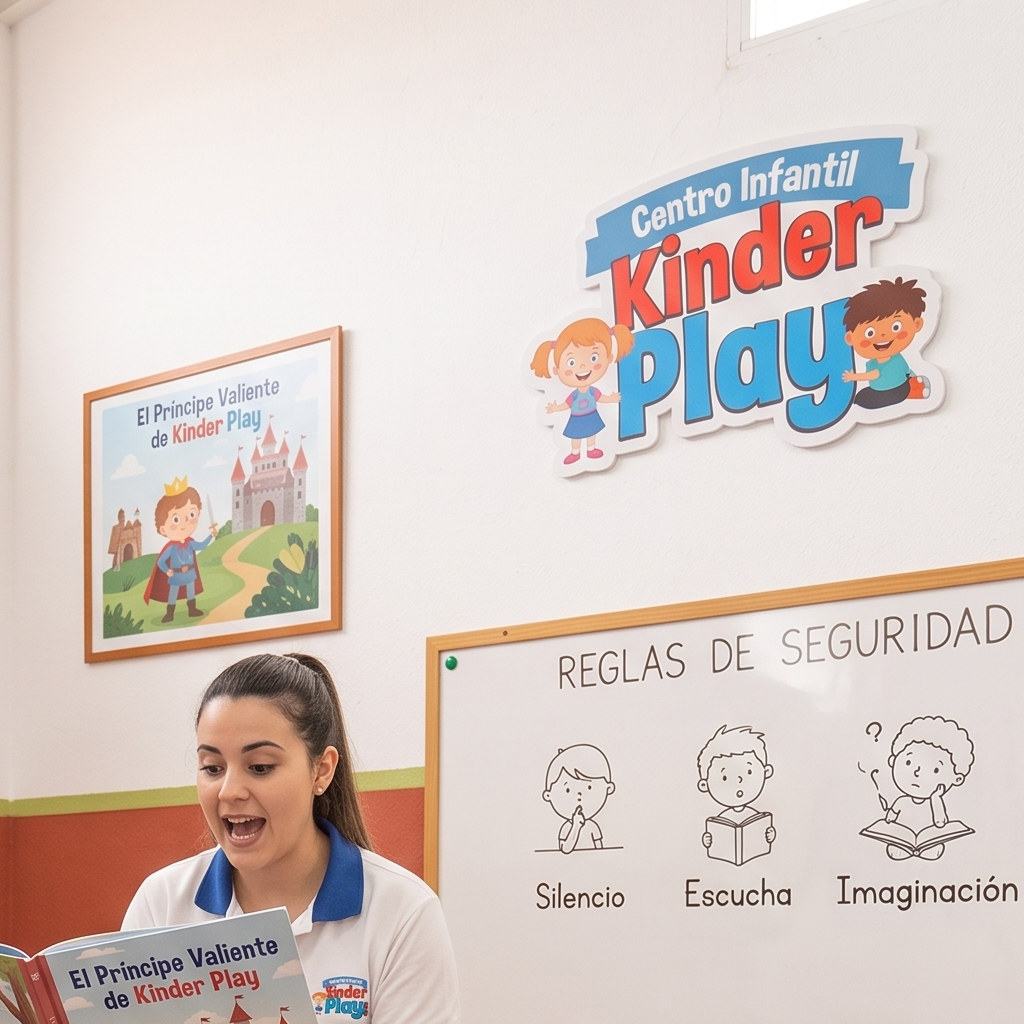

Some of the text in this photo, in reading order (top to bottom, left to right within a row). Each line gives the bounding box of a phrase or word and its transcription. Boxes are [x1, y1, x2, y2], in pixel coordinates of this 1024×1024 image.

[631, 150, 860, 239] Centro Infantil
[610, 196, 884, 331] Kinder
[617, 297, 857, 442] Play
[137, 378, 280, 427] El Príncipe Valiente
[151, 409, 262, 449] de Kinder Play
[558, 603, 1014, 690] REGLAS DE SEGURIDAD
[535, 882, 626, 910] Silencio
[684, 877, 792, 907] Escucha
[836, 874, 1020, 911] Imaginación
[69, 937, 279, 990] El Príncipe Valiente
[104, 969, 261, 1010] de Kinder Play
[324, 997, 364, 1020] Play
